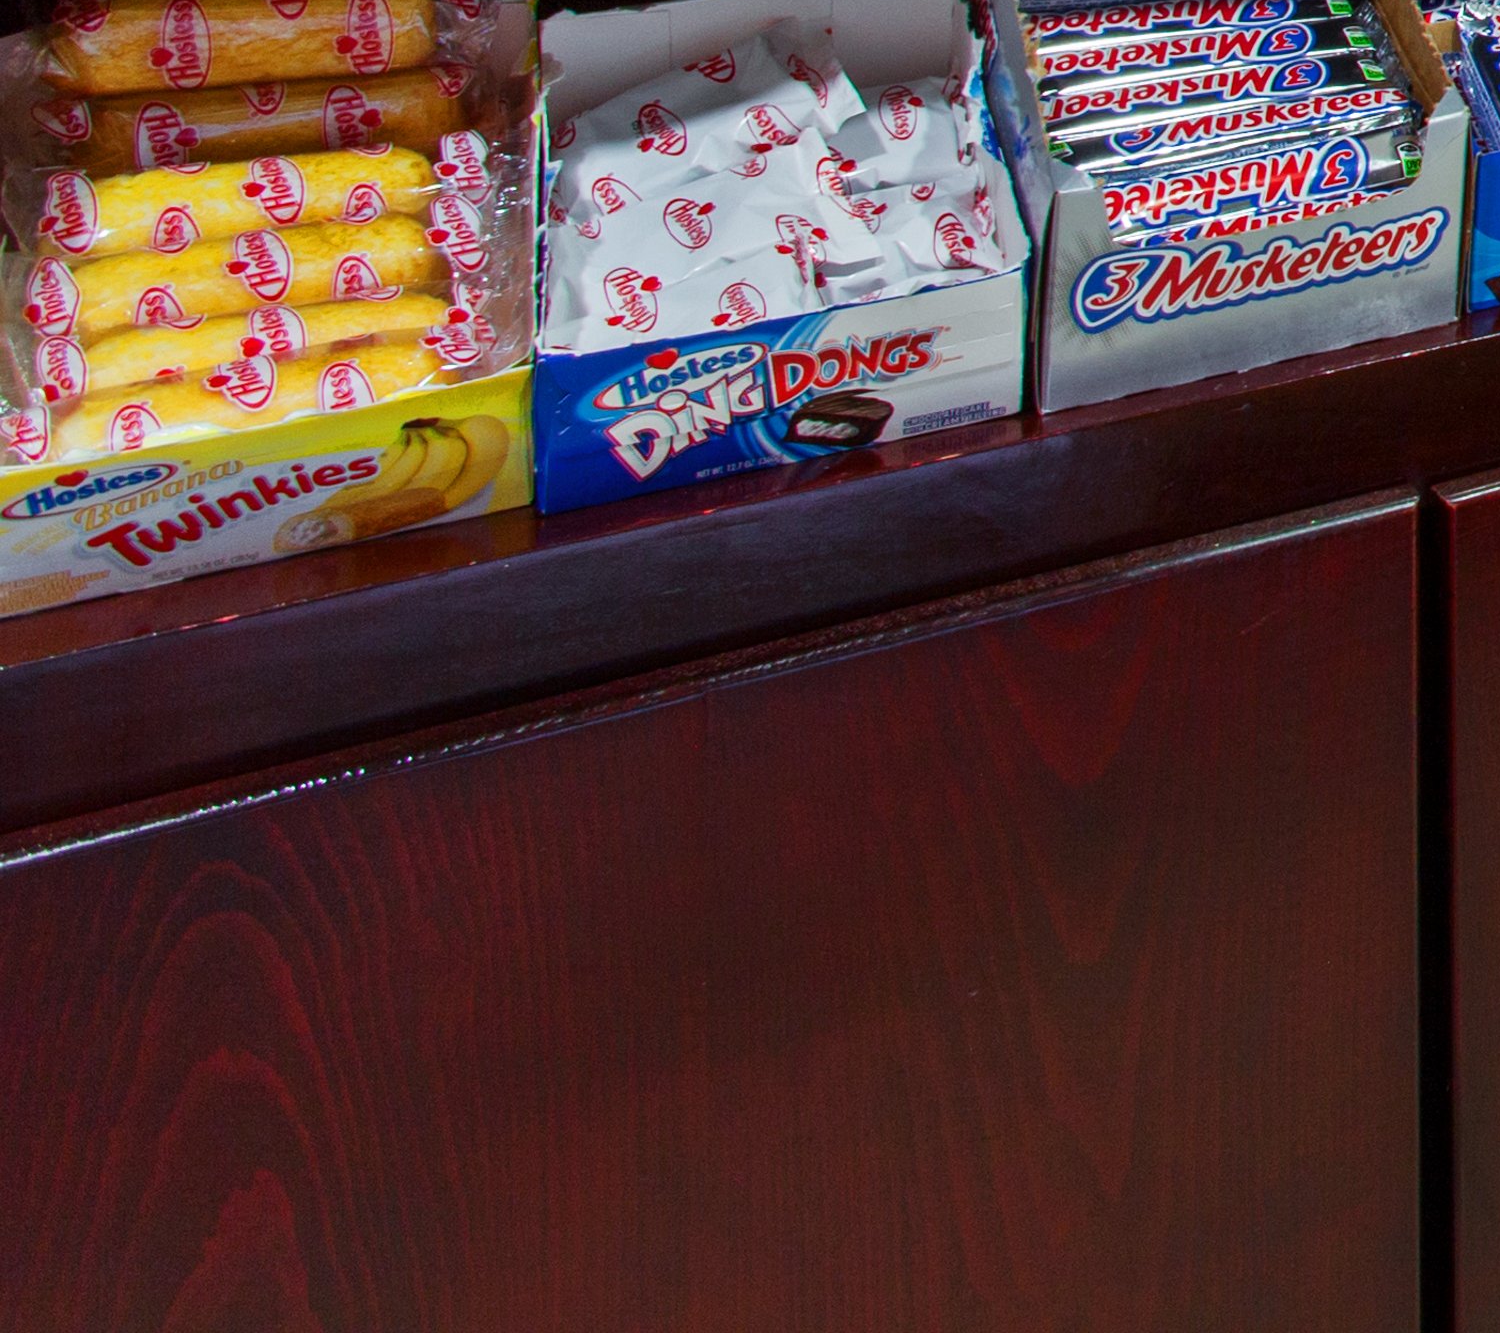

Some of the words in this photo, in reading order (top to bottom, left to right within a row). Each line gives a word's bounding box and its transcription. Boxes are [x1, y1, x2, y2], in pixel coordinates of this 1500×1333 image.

[1085, 260, 1145, 310] 3
[1140, 213, 1440, 313] Musketeers
[620, 343, 756, 403] Hostess
[768, 331, 940, 407] DONGS
[26, 464, 163, 517] Hostess
[74, 459, 244, 534] Banana
[87, 454, 380, 568] Twinkies
